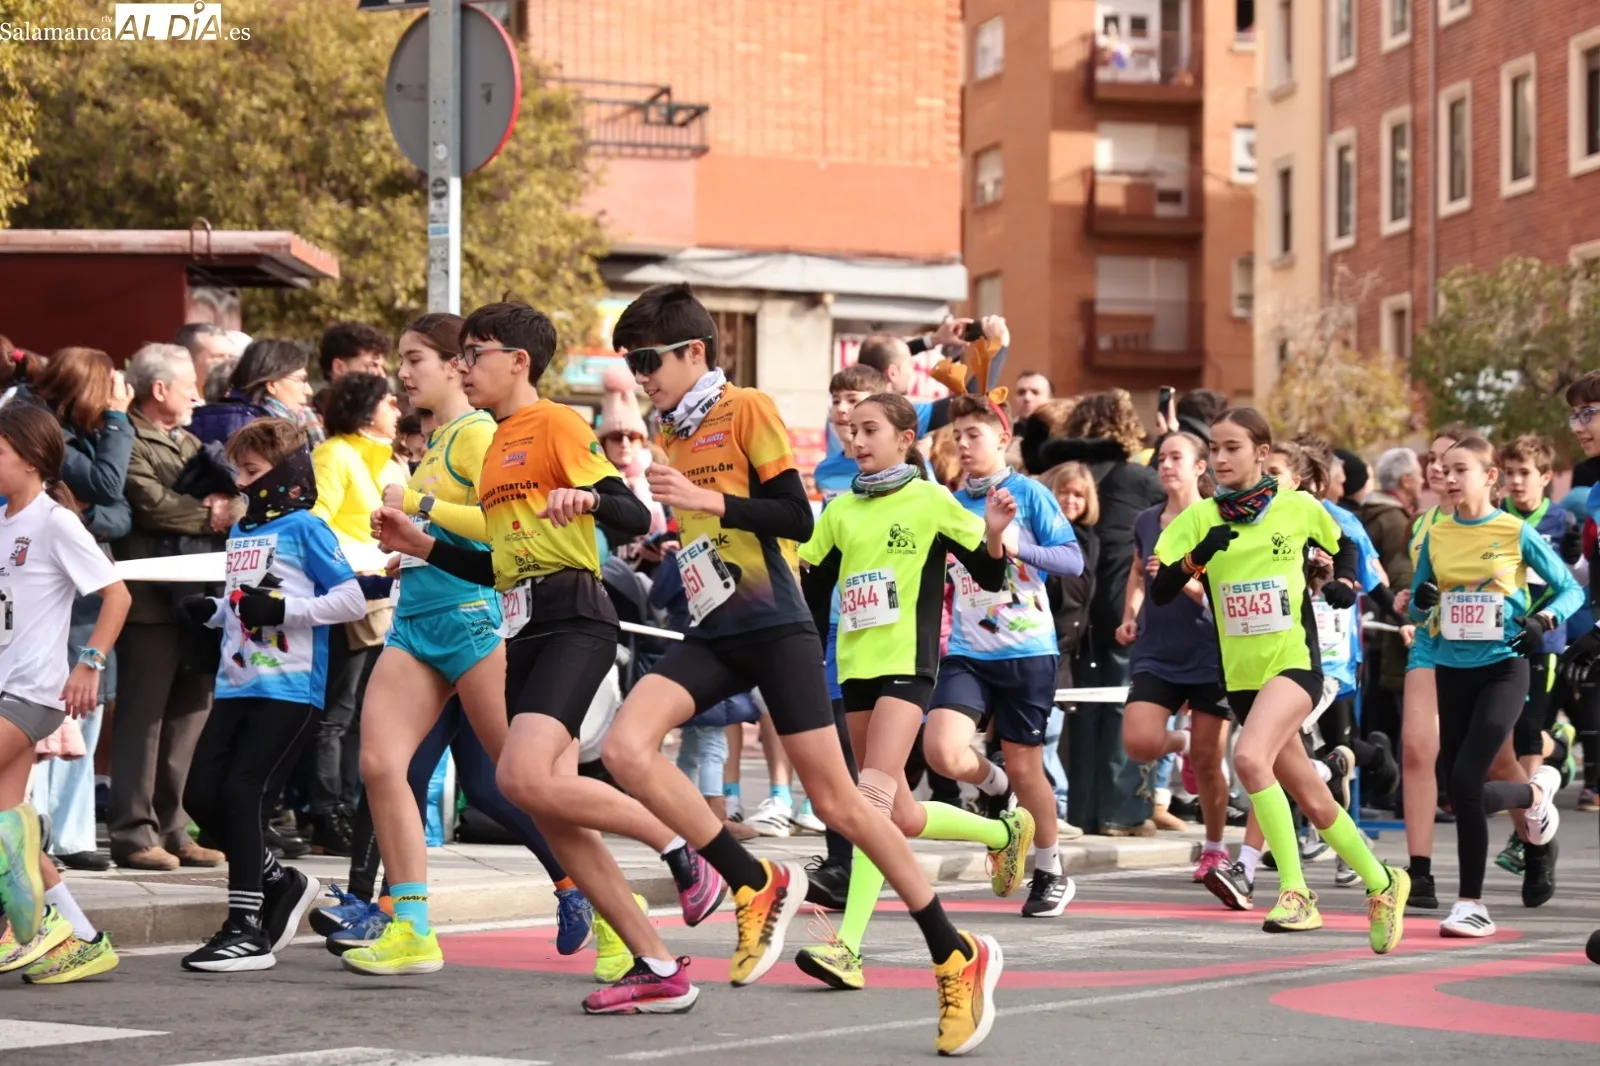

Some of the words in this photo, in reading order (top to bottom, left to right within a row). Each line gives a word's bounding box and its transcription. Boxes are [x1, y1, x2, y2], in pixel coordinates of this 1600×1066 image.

[234, 538, 272, 549] SETEL
[227, 549, 262, 574] 6220
[677, 543, 706, 569] ETEL
[845, 571, 888, 588] SETEL
[1232, 580, 1280, 594] SETEL
[1226, 593, 1273, 618] 6343
[1457, 594, 1497, 603] SETEL
[1451, 605, 1485, 624] 6182
